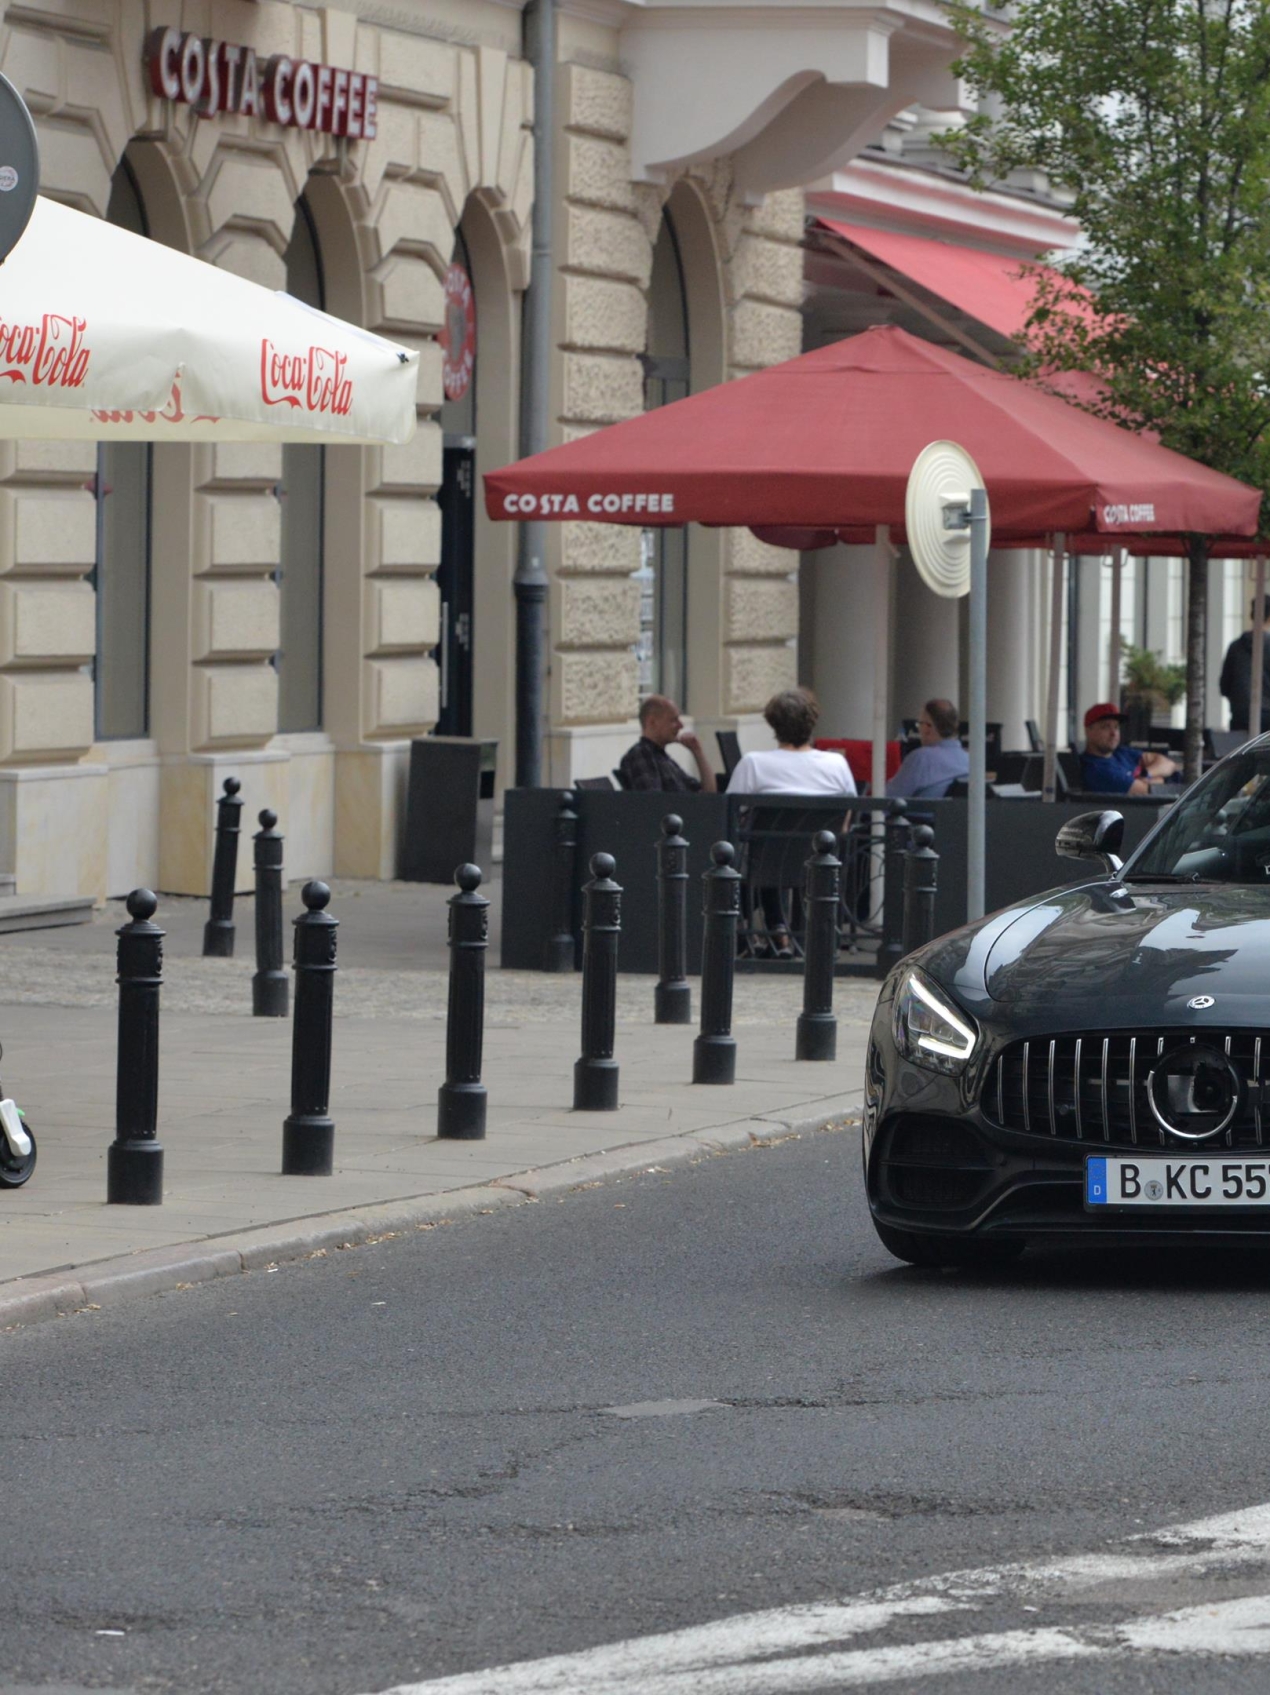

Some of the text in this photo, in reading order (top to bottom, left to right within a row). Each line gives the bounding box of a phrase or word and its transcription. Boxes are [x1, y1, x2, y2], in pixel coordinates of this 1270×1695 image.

[159, 26, 379, 140] COSTA COFFEE
[503, 493, 674, 515] COSTA COFFEE
[1103, 503, 1155, 525] COSTA COFFEE
[1094, 1185, 1101, 1196] D
[1120, 1164, 1141, 1199] B
[1166, 1164, 1212, 1200] KC
